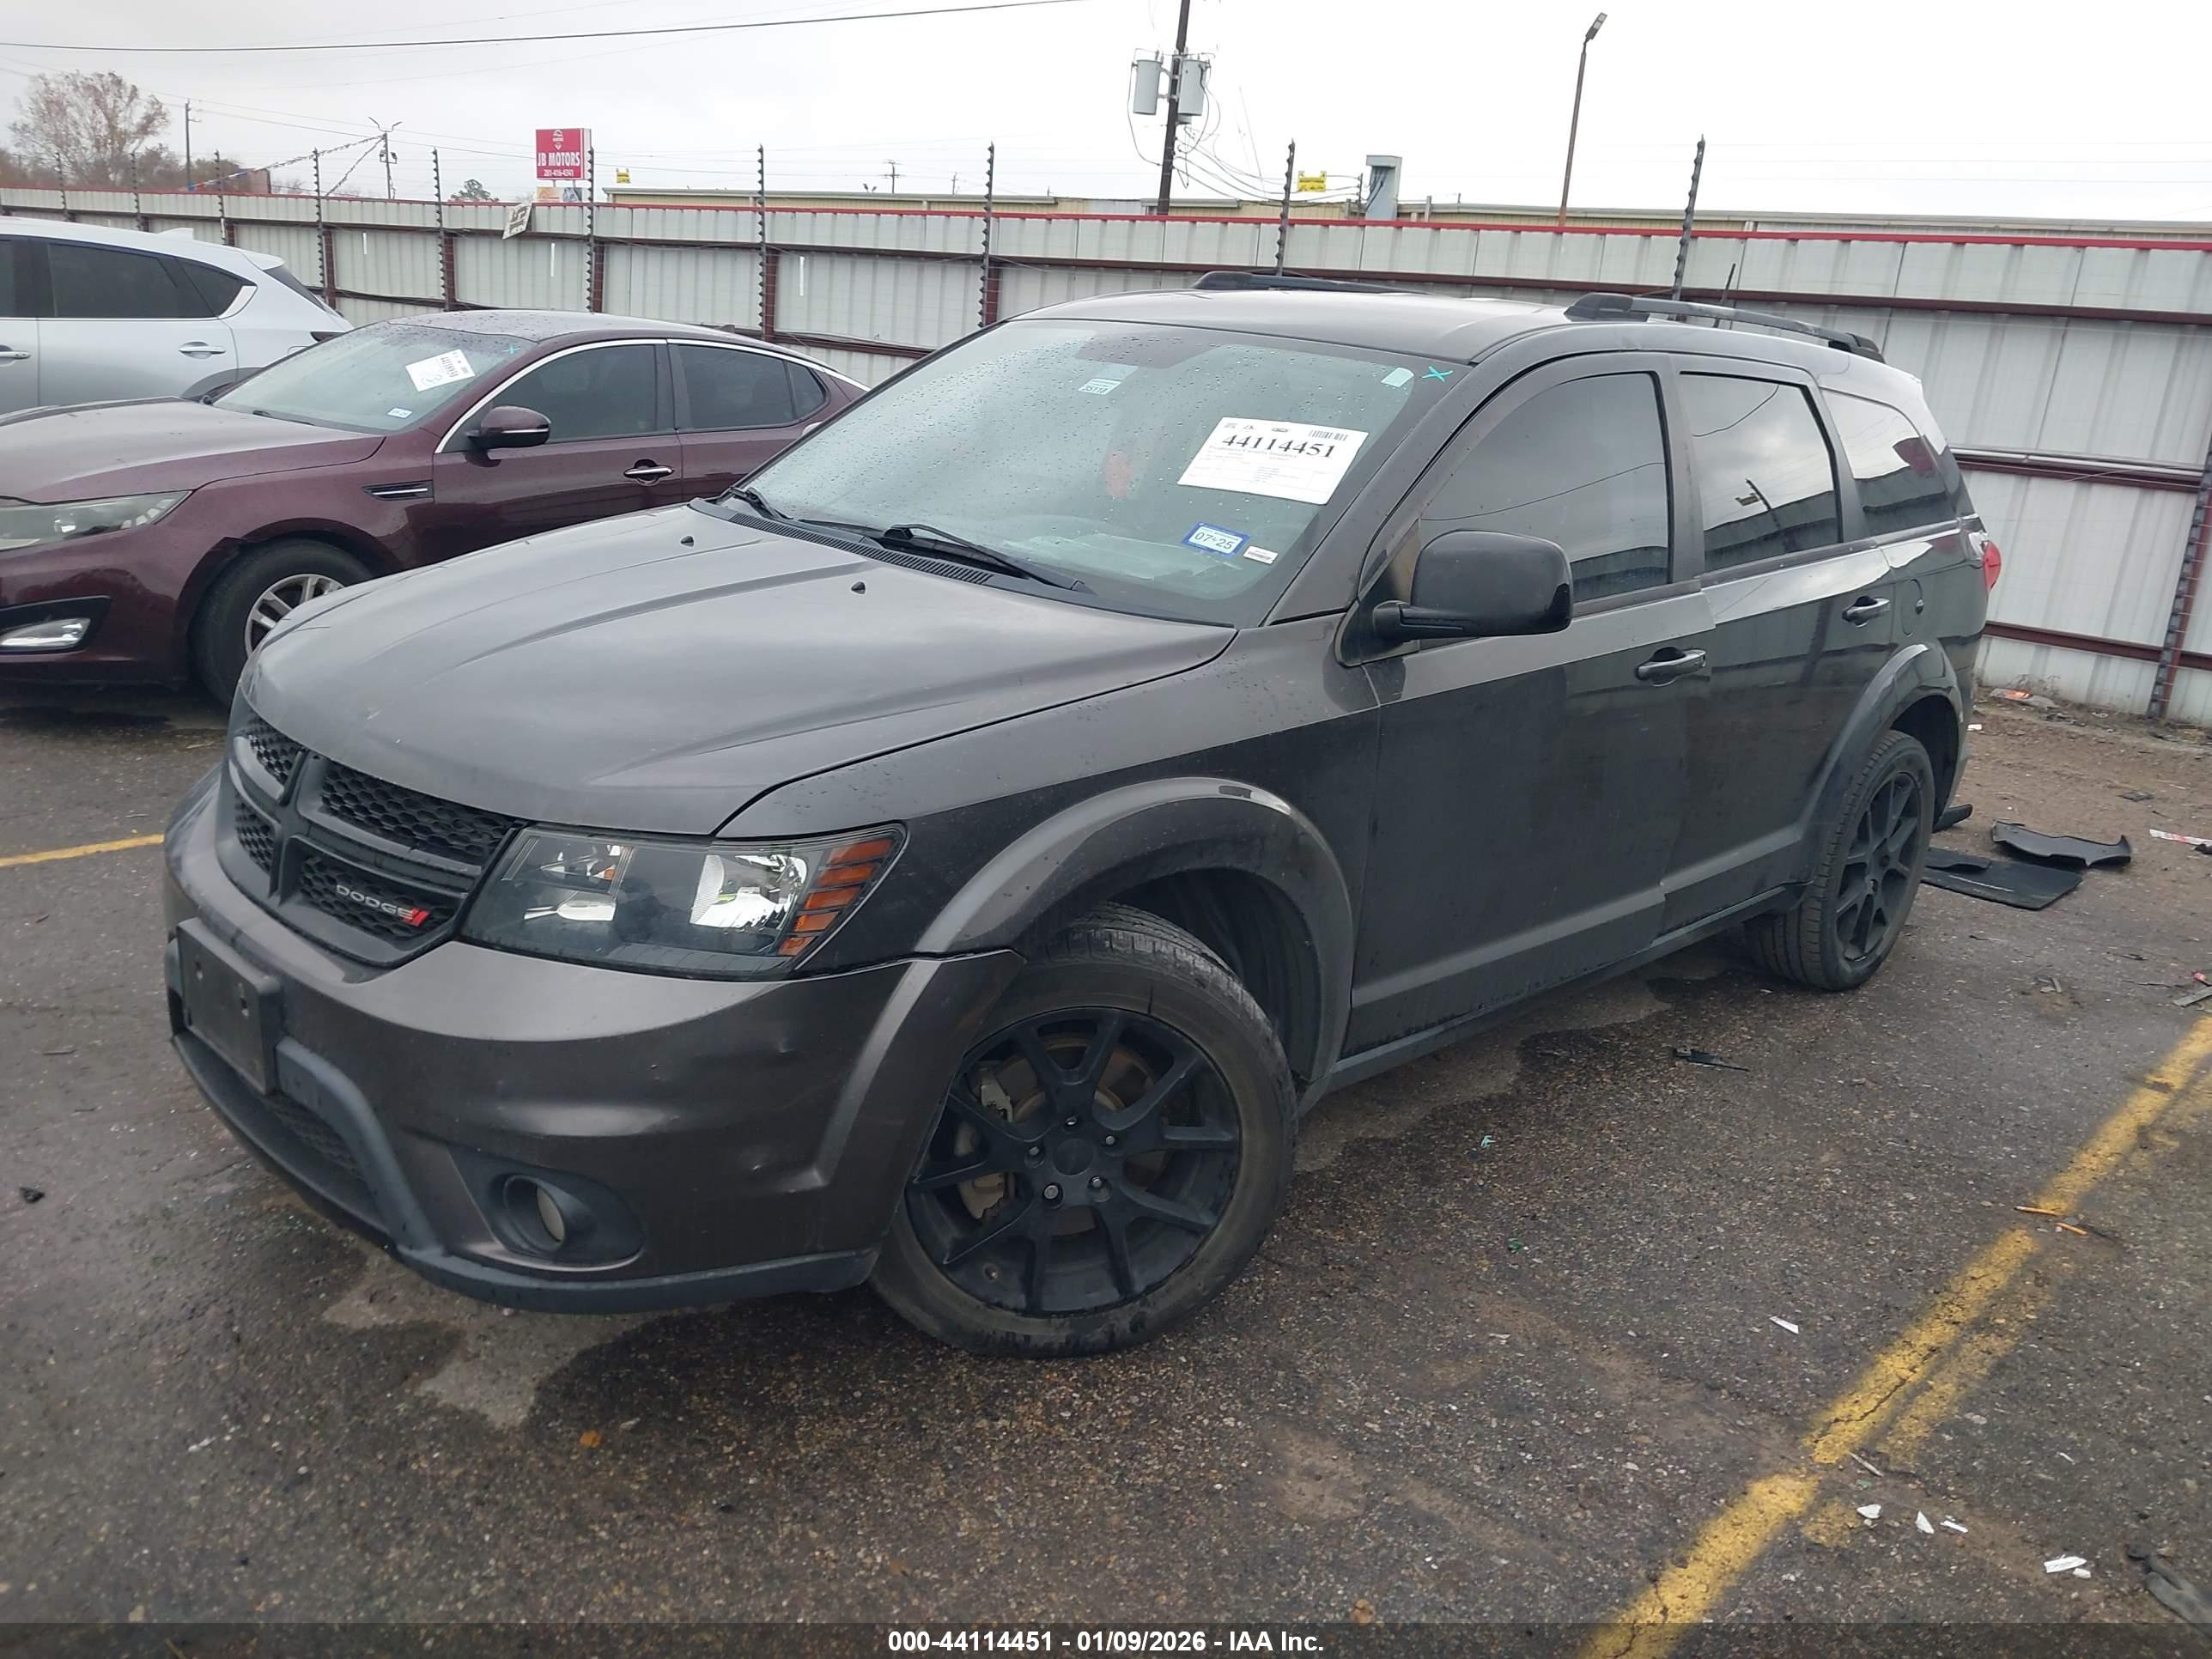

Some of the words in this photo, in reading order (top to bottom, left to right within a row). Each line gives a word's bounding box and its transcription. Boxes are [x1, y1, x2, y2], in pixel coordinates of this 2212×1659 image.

[538, 152, 547, 167] JB
[548, 151, 580, 167] MOTORS
[1222, 434, 1335, 458] 44114451
[336, 884, 414, 921] DODGE
